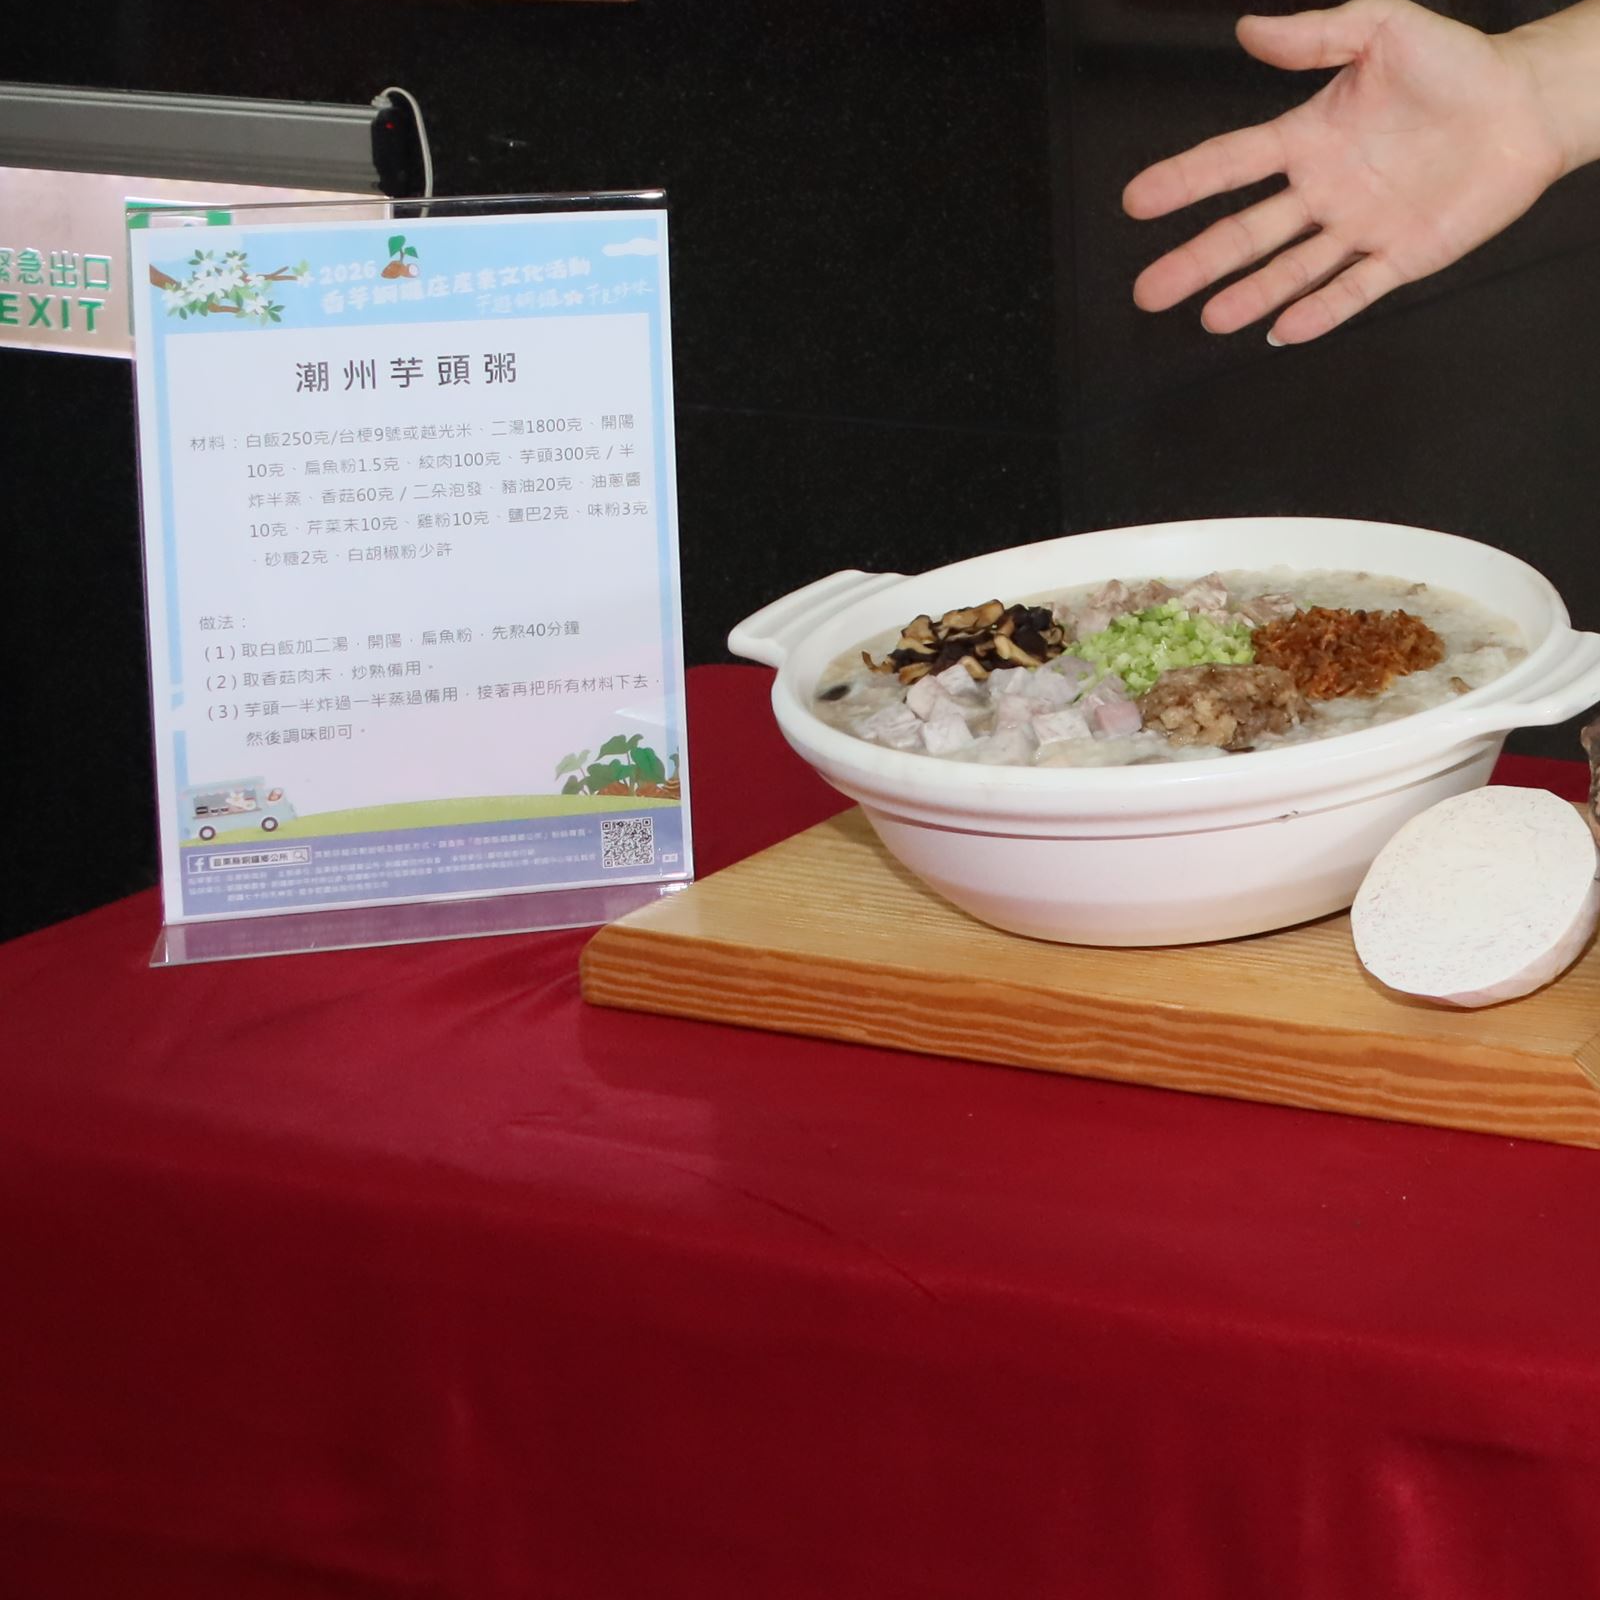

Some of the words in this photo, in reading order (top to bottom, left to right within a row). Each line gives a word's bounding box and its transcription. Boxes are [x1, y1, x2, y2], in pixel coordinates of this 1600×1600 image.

[320, 260, 376, 285] 2026
[0, 291, 105, 333] EXIT
[294, 351, 518, 393] 潮州芋頭粥
